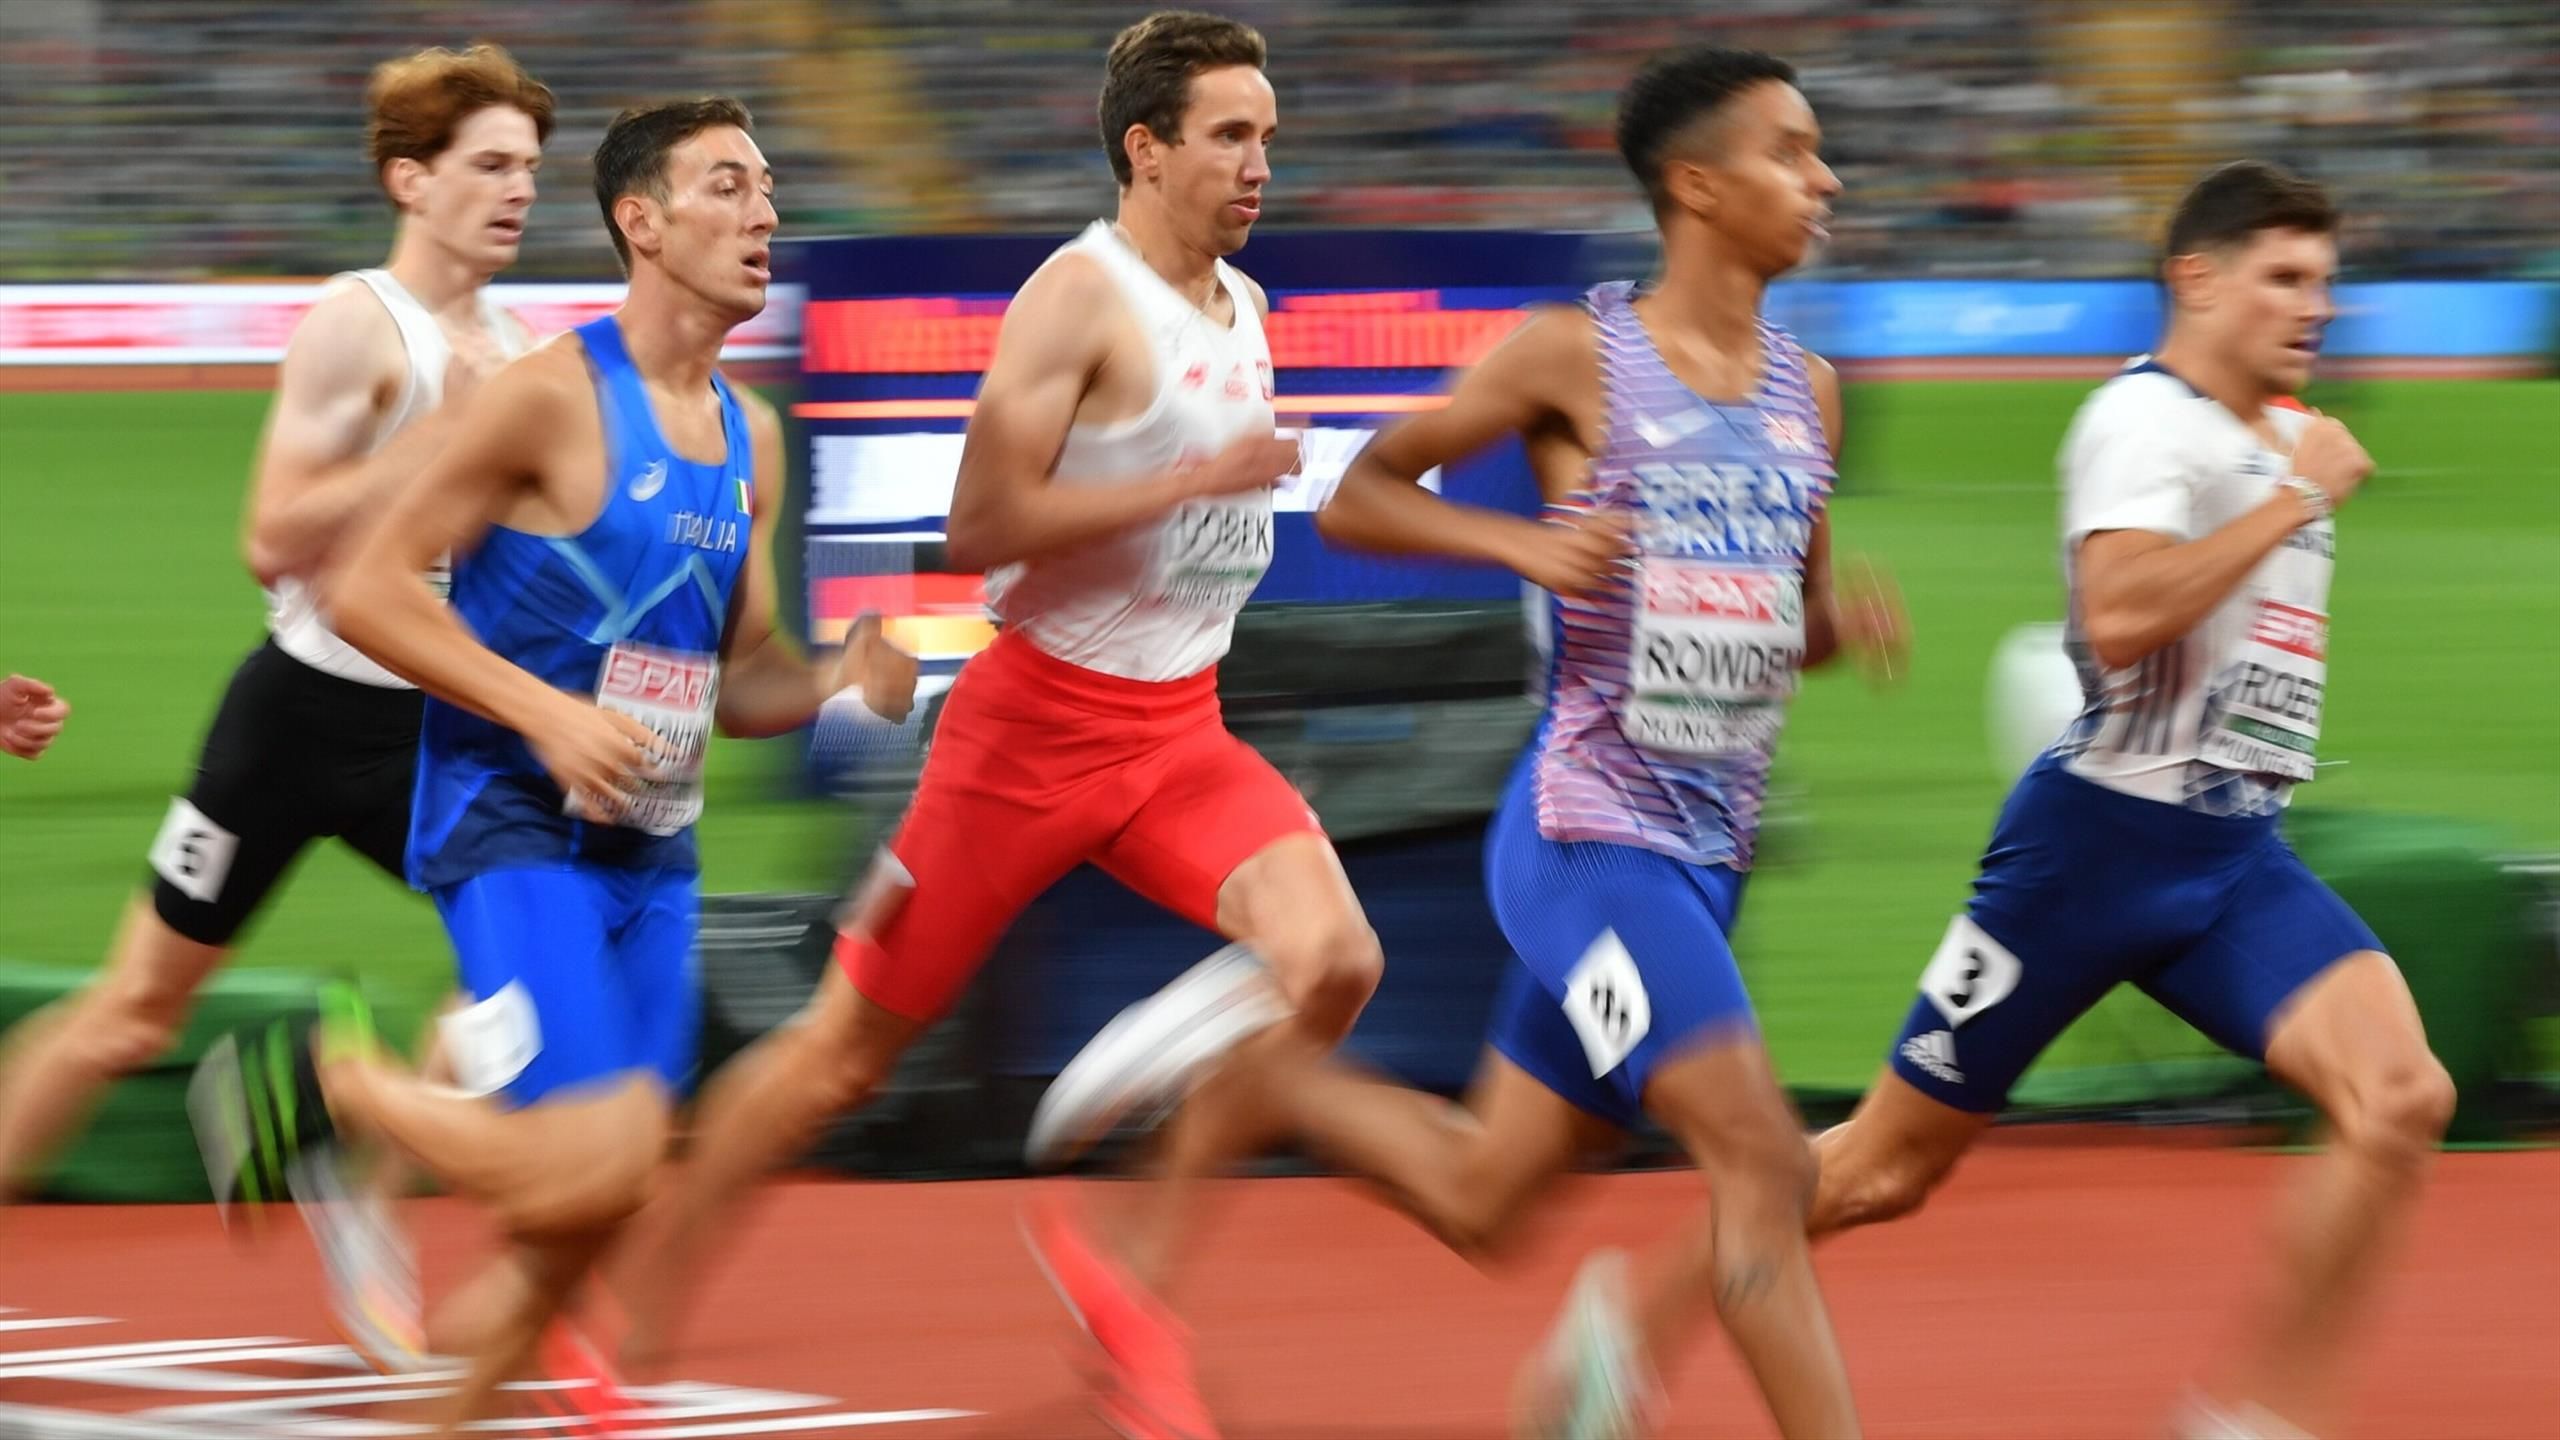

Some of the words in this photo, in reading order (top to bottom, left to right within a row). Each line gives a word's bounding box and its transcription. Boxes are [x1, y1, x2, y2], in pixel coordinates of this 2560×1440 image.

[1634, 463, 1812, 513] GREAT
[672, 510, 737, 554] ITALIA
[1645, 566, 1778, 622] SPAR
[606, 652, 713, 708] SPAR
[1642, 628, 1802, 694] ROWDEN
[1949, 947, 1988, 1008] 3
